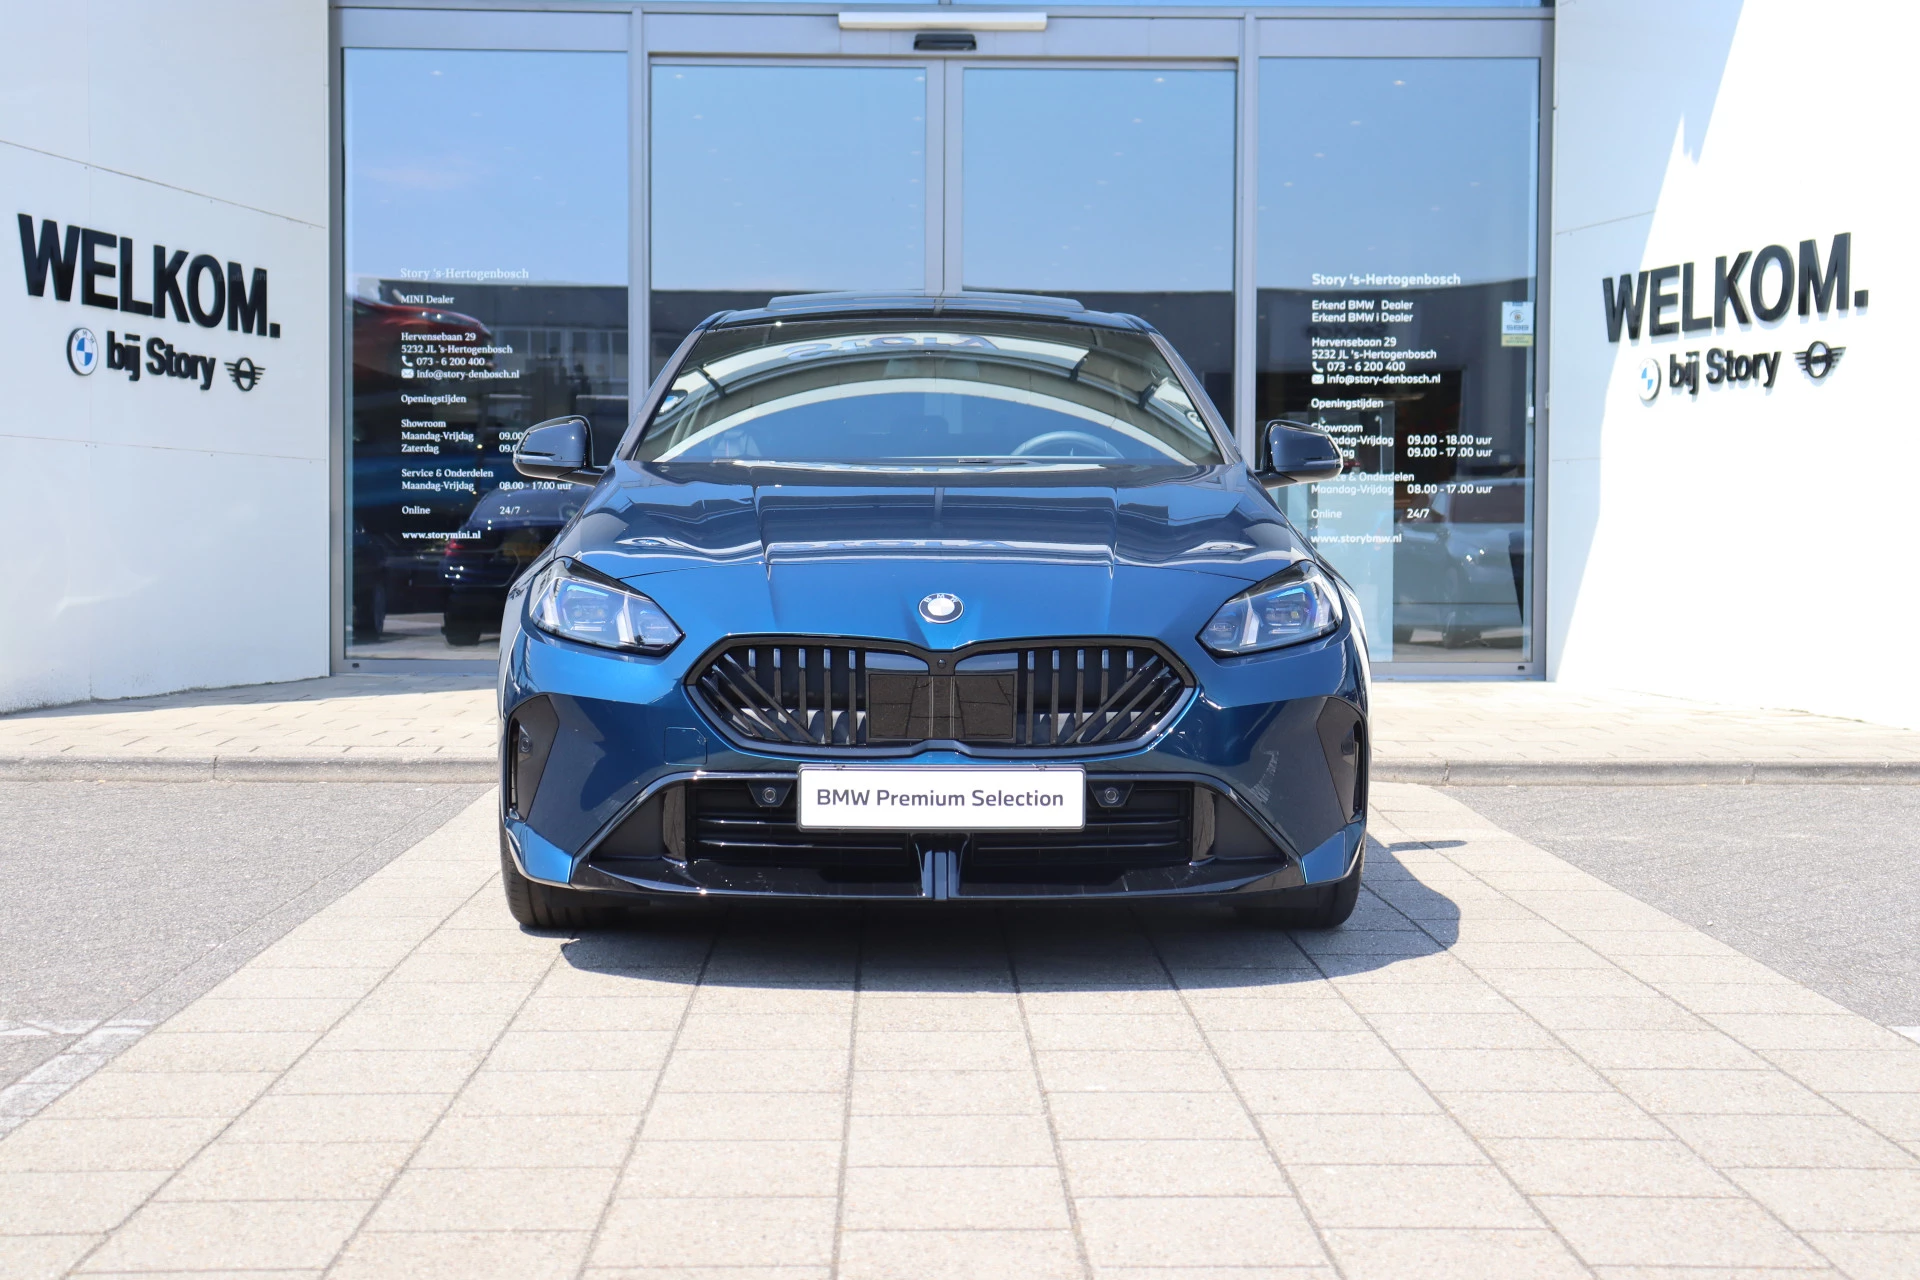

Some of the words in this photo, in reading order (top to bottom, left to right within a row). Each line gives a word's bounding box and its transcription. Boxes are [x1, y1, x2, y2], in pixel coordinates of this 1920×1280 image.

[17, 213, 280, 338] WELKOM.
[400, 268, 430, 279] Story
[1311, 273, 1346, 287] Story
[1602, 232, 1869, 343] WELKOM.
[401, 295, 424, 304] MINI
[426, 295, 454, 304] Dealer
[1311, 300, 1346, 310] Erkend
[1348, 300, 1375, 310] BMW
[1381, 300, 1413, 310] Dealer
[1311, 313, 1346, 322] Erkend
[1348, 313, 1374, 322] BMW
[1381, 313, 1413, 322] Dealer
[401, 333, 463, 341] Hervensebaan
[464, 333, 476, 341] 29
[1311, 337, 1382, 347] Hervensebaan
[1384, 337, 1397, 347] 29
[401, 345, 423, 353] 5232
[425, 345, 437, 354] JL
[1311, 350, 1336, 359] 5232
[1338, 350, 1349, 359] JL
[107, 331, 141, 382] bij
[146, 337, 217, 391] Story
[416, 357, 433, 366] 073
[441, 357, 447, 366] 6
[449, 357, 466, 366] 200
[468, 357, 485, 366] 400
[1327, 362, 1346, 371] 073
[1354, 362, 1361, 371] 6
[1363, 362, 1383, 371] 200
[1385, 362, 1406, 371] 400
[1669, 351, 1700, 395] bij
[1706, 348, 1782, 388] Story
[416, 369, 520, 380] info@story-denbosch.nl
[1327, 374, 1441, 385] info@story-denbosch.nl
[401, 394, 467, 404] Openingstijden
[1311, 398, 1384, 410] Openingstijden
[401, 419, 446, 428] Showroom
[401, 432, 474, 442] Maandag-Vrijdag
[1407, 435, 1437, 445] 09.00
[1446, 435, 1474, 445] 18.00
[1476, 437, 1492, 445] uur
[401, 444, 439, 454] Zaterdag
[1407, 448, 1437, 457] 09.00
[401, 469, 434, 477] Service
[436, 469, 442, 477] &
[444, 469, 494, 477] Onderdelen
[1348, 472, 1356, 481] &
[1359, 472, 1414, 481] Onderdelen
[402, 481, 474, 491] Maandag-Vrijdag
[499, 481, 524, 490] 08.00
[532, 481, 555, 490] 17.00
[1311, 485, 1394, 496] Maandag-Vrijdag
[1407, 485, 1437, 494] 08.00
[402, 506, 431, 514] Online
[499, 506, 520, 515] 24/7
[1311, 509, 1342, 518] Online
[1407, 509, 1430, 519] 24/7
[402, 531, 481, 540] www.storymini.nl
[1311, 534, 1402, 544] www.storybmw.nl
[817, 788, 870, 806] BMW
[876, 789, 965, 806] Premium
[971, 789, 1064, 806] Selection
